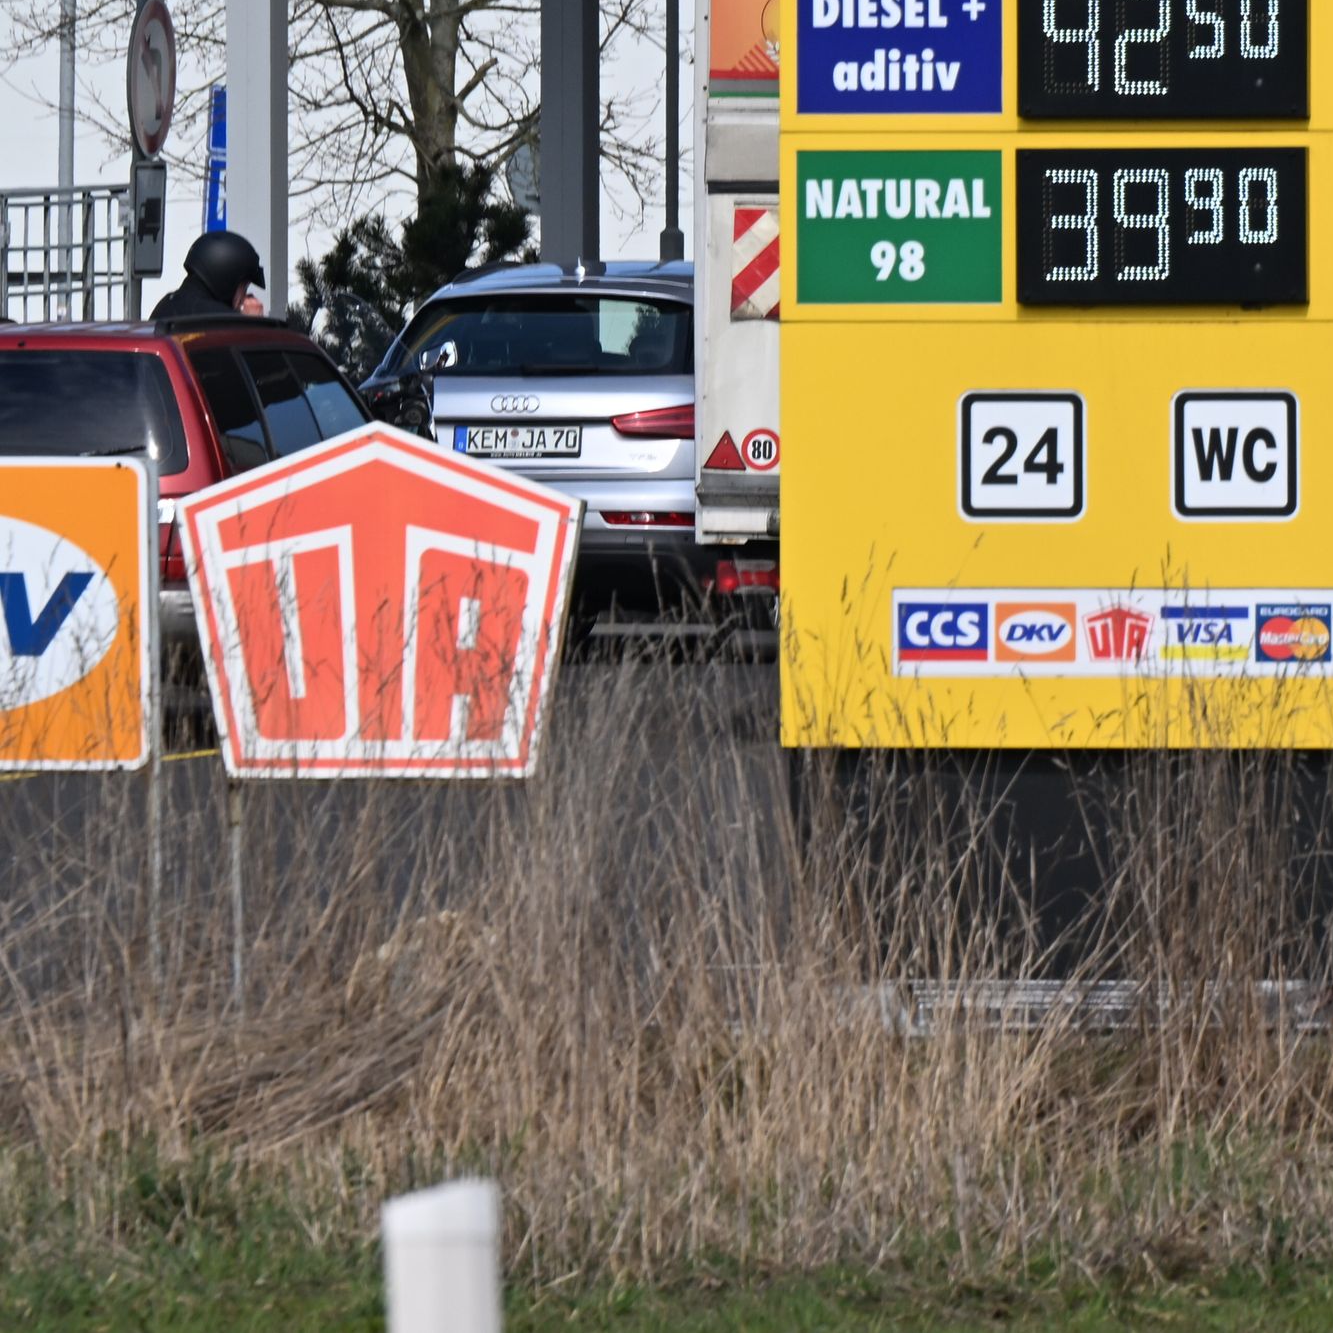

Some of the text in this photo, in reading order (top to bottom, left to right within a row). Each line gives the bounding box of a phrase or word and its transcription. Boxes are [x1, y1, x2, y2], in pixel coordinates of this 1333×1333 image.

[832, 48, 962, 92] aditiv
[805, 178, 992, 220] NATURAL
[870, 240, 927, 283] 98
[467, 429, 578, 449] KEM JA 70
[751, 440, 773, 460] 80
[980, 427, 1065, 485] 24
[1191, 427, 1278, 484] WC
[906, 611, 981, 646] CCS
[1006, 623, 1067, 642] DKV
[1176, 621, 1234, 643] VISA
